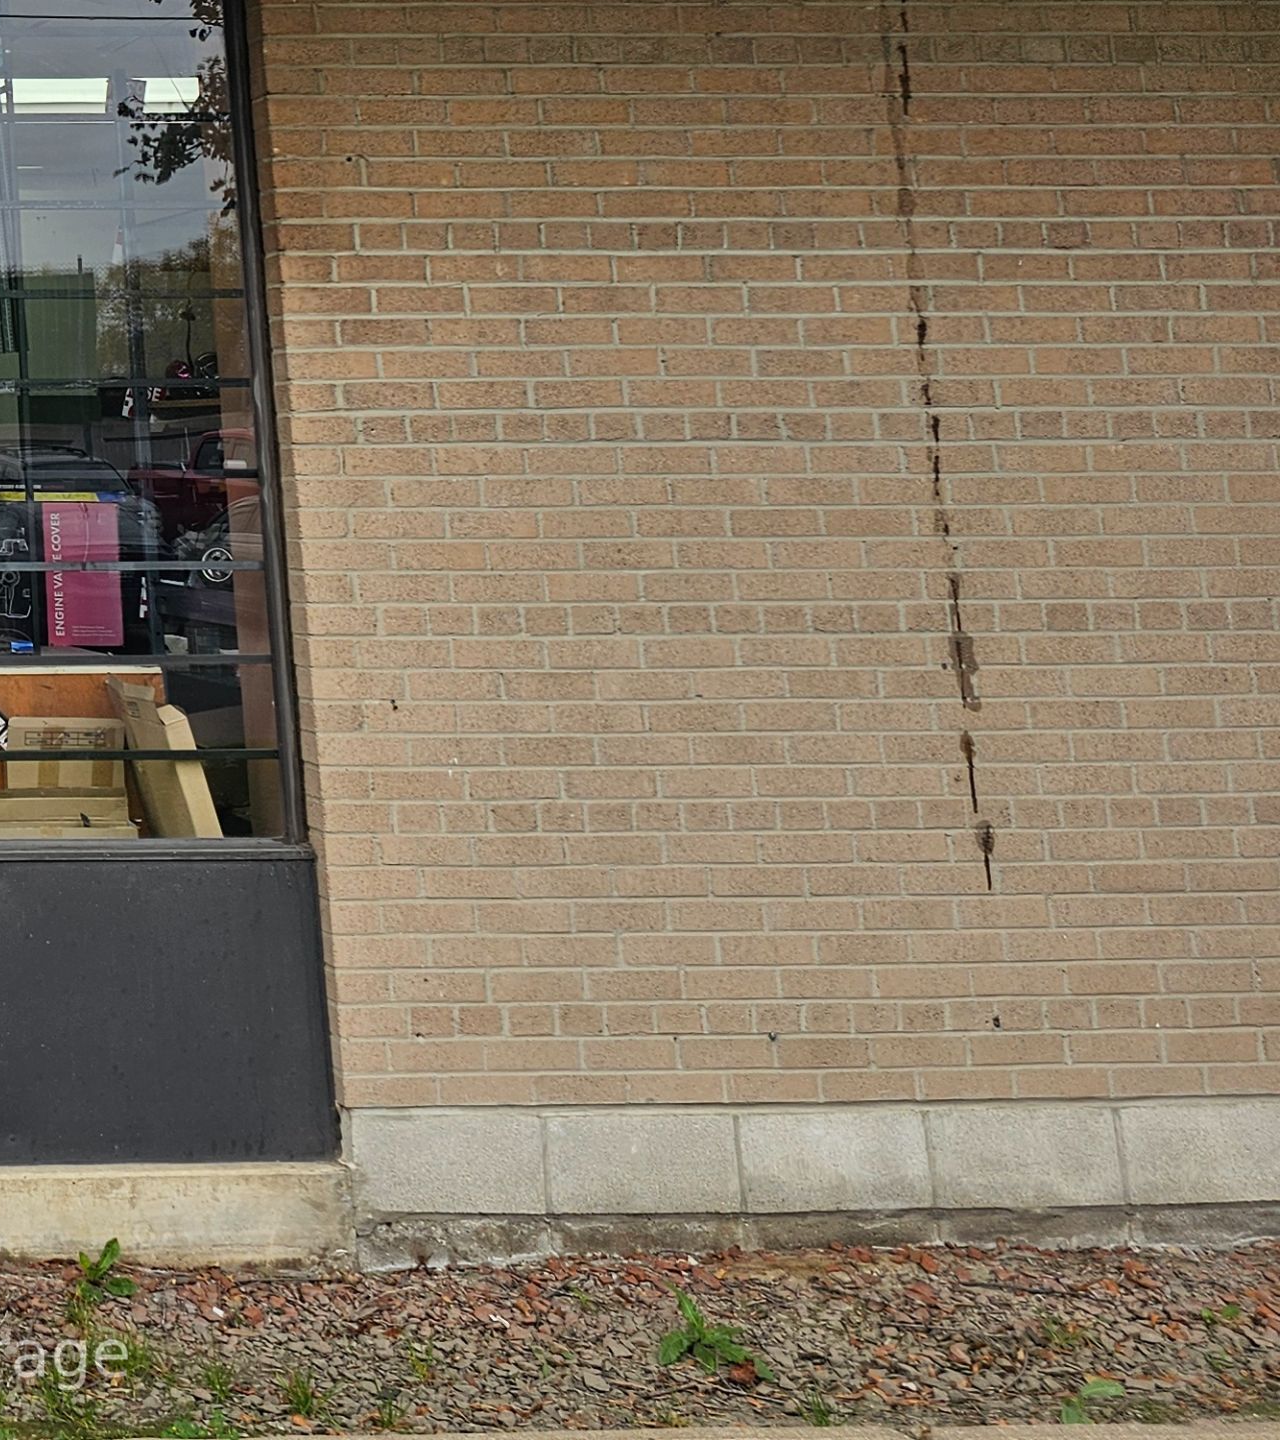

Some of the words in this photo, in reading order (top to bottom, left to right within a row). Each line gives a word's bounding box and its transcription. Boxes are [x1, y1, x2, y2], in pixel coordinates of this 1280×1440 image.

[49, 512, 62, 552] COVER
[51, 553, 64, 589] VAE
[54, 590, 66, 637] ENGINE
